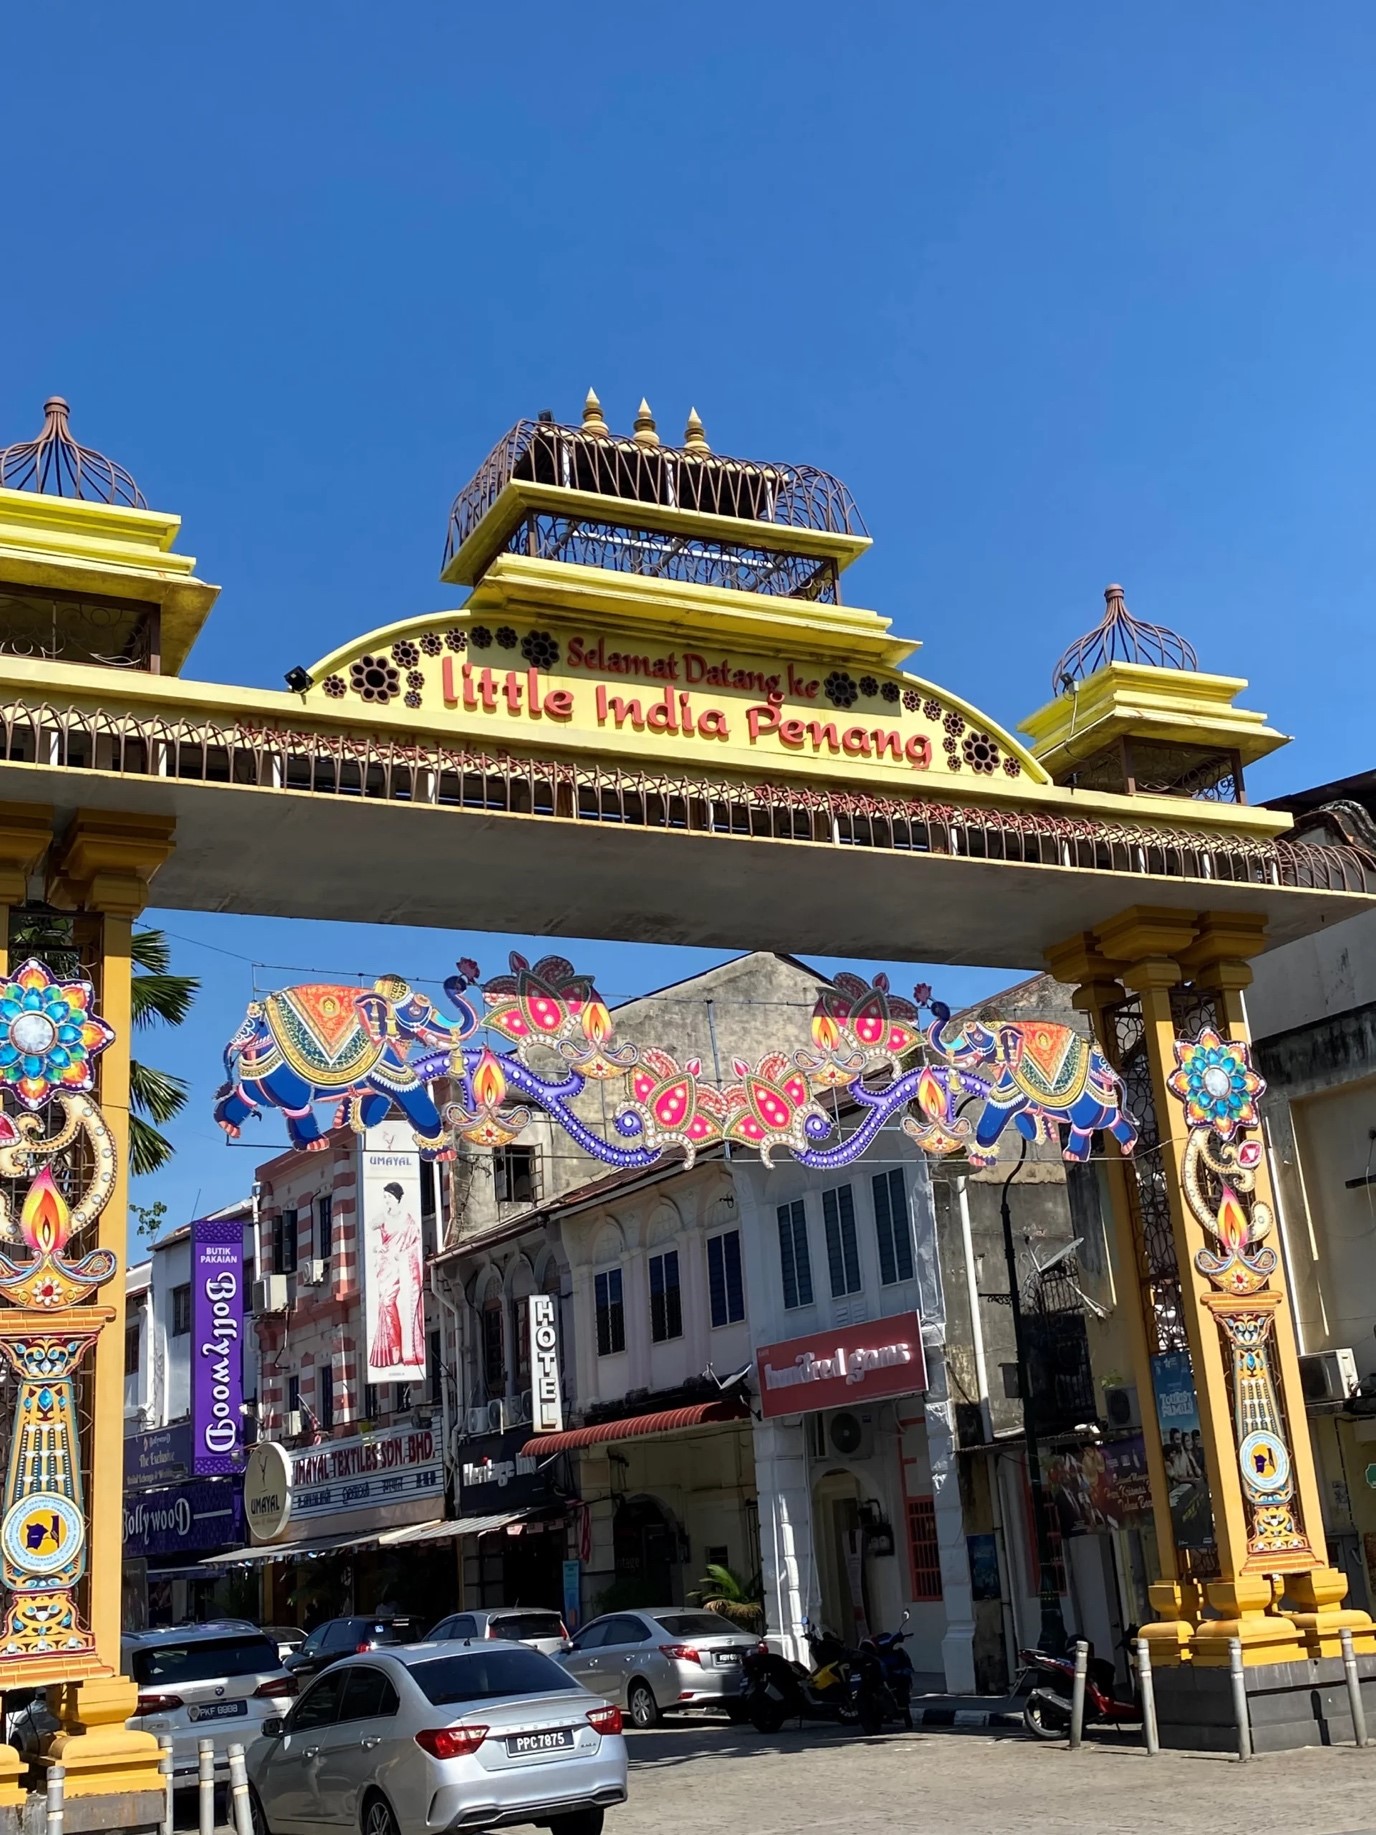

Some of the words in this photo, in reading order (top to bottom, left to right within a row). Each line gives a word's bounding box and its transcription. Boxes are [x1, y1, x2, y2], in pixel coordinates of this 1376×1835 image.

[567, 636, 680, 680] Selamat
[683, 653, 784, 706] Datang
[787, 663, 820, 699] ke
[596, 685, 731, 741] India
[746, 704, 932, 770] Penang
[370, 1156, 412, 1166] UMAYAL
[200, 1255, 237, 1264] PAKAIAN
[206, 1247, 231, 1256] BUTIK
[536, 1301, 557, 1429] HOTEL
[764, 1348, 847, 1390] hundred
[846, 1343, 911, 1385] grams
[331, 1443, 378, 1478] TEXTILES
[408, 1431, 436, 1464] BHD.
[250, 1494, 280, 1515] UMAYAL
[200, 1706, 215, 1717] PKF
